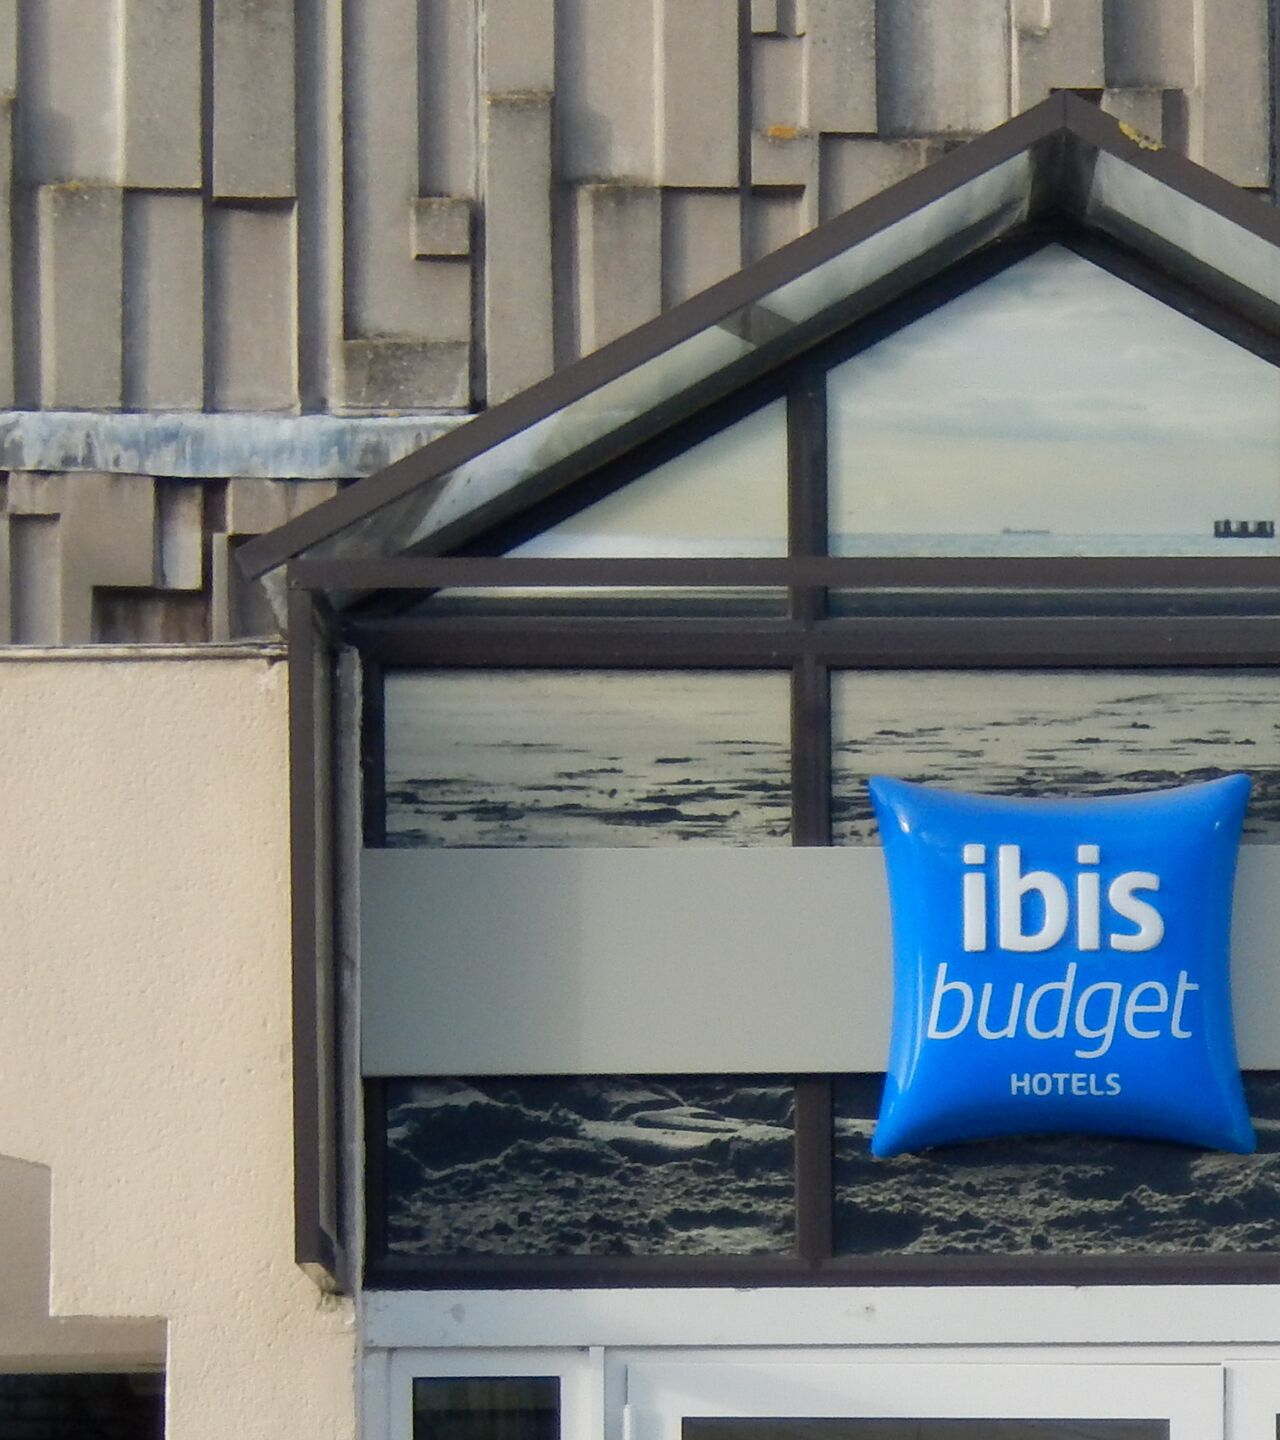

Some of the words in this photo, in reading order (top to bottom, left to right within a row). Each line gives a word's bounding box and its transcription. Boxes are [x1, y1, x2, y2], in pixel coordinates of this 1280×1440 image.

[962, 843, 1165, 953] ibis
[926, 962, 1199, 1059] budget
[1009, 1073, 1122, 1096] HOTELS
